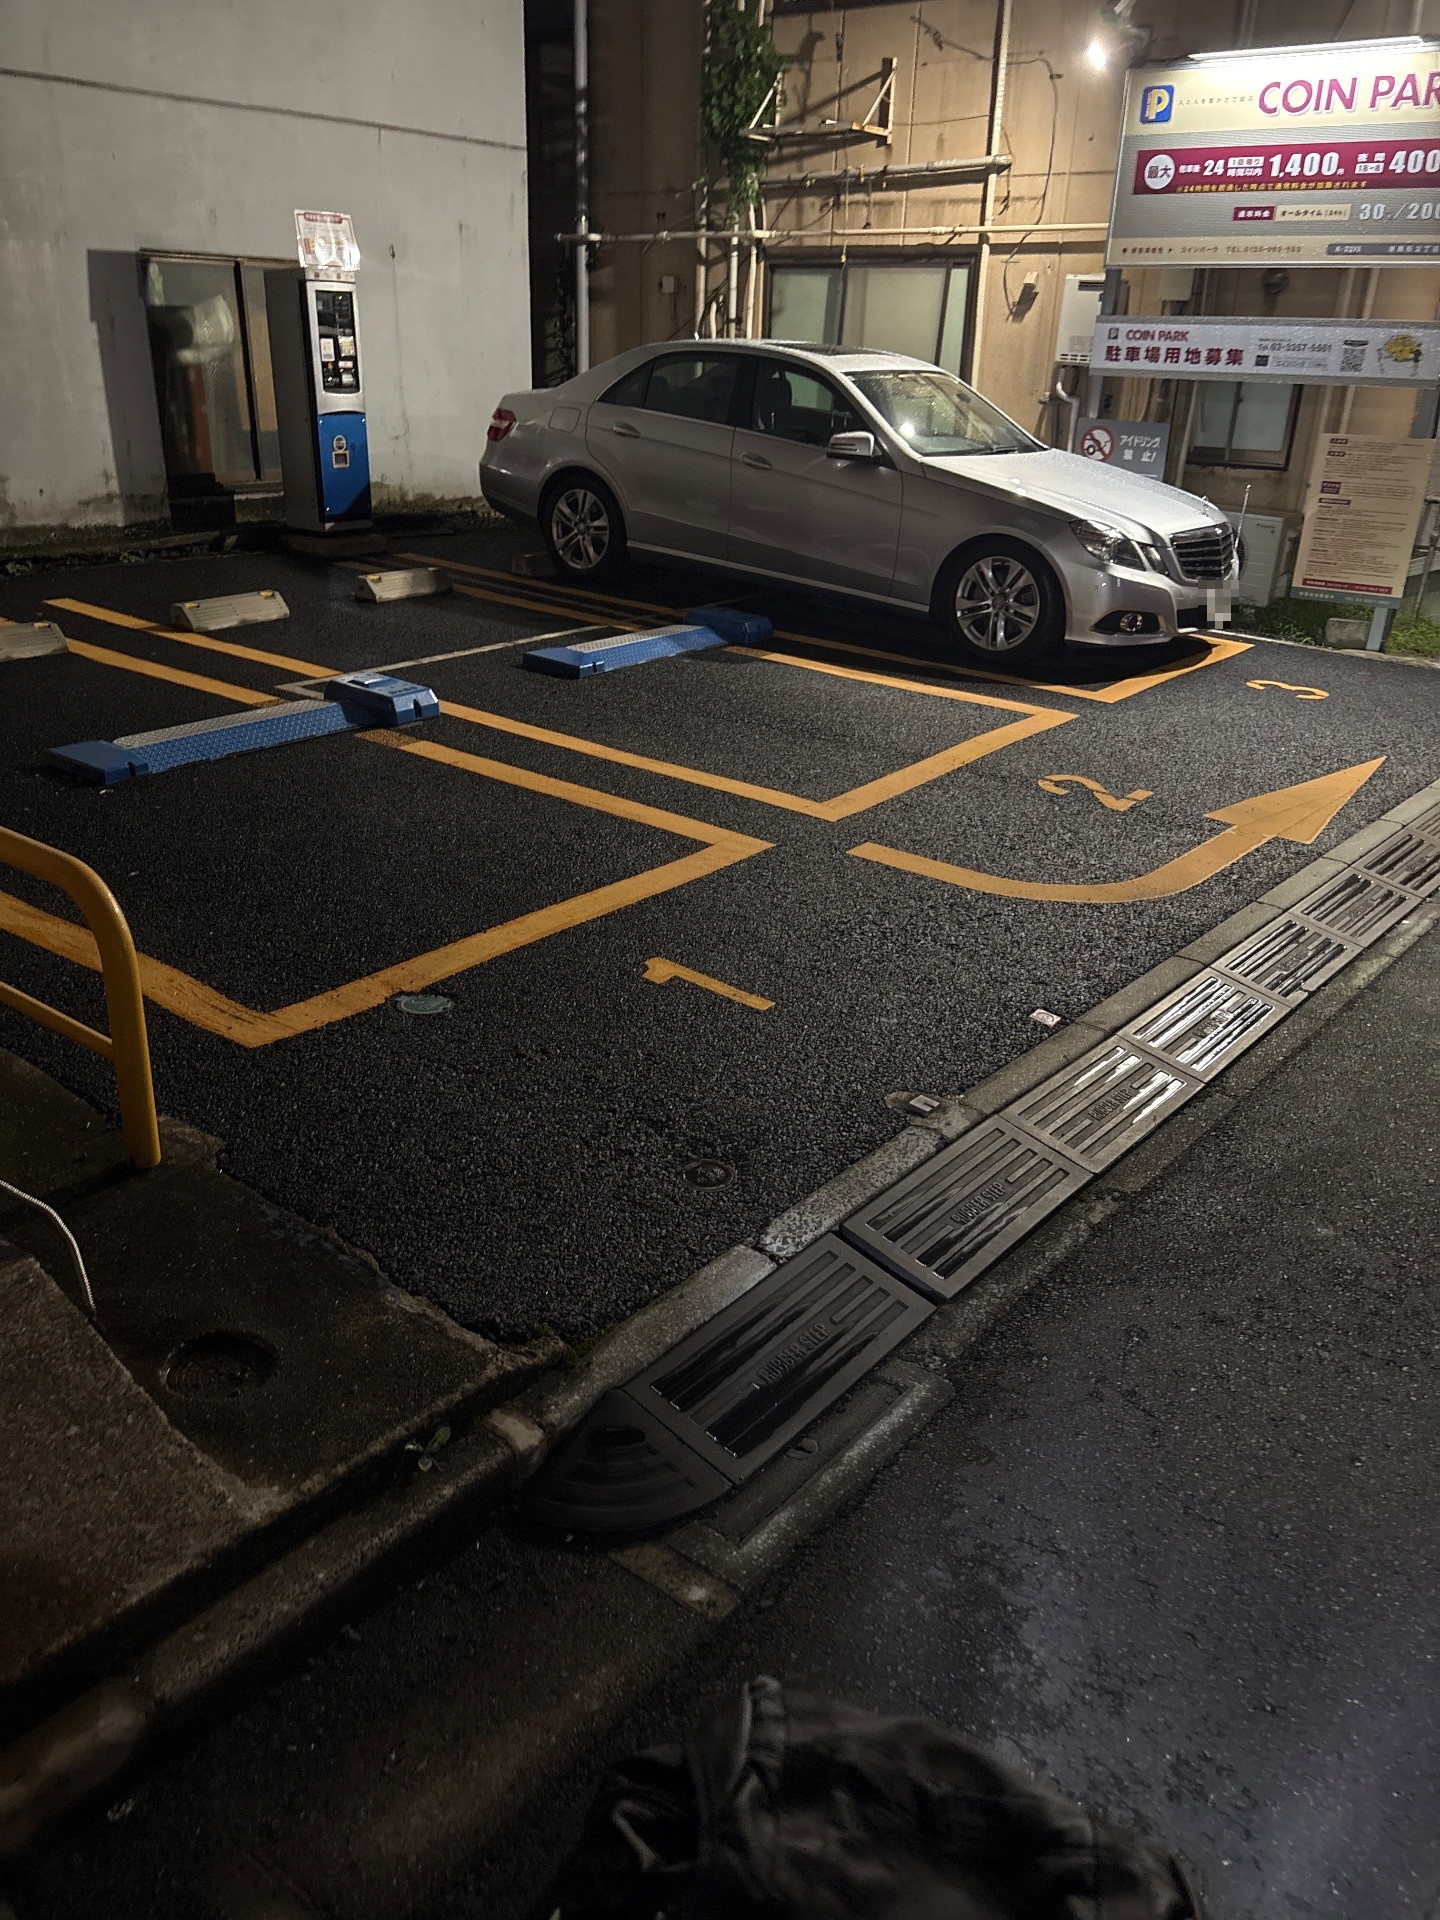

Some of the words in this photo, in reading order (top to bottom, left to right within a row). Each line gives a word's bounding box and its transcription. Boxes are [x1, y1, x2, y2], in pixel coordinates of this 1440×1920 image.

[1258, 76, 1358, 116] COIN
[1368, 71, 1440, 109] PAR
[1146, 164, 1172, 179] 最大
[1202, 159, 1225, 176] 24
[1125, 328, 1156, 341] COIN
[1158, 330, 1190, 342] PARK
[1104, 345, 1244, 366] 駐車場用地募集
[1120, 434, 1162, 448] アイドリング
[1246, 679, 1330, 700] 3
[1037, 774, 1153, 811] 2
[642, 957, 775, 1012] 1
[950, 1195, 990, 1224] RUBBER
[981, 1181, 1006, 1202] STEP
[756, 1342, 808, 1386] RUBBER
[798, 1322, 829, 1351] STEP
